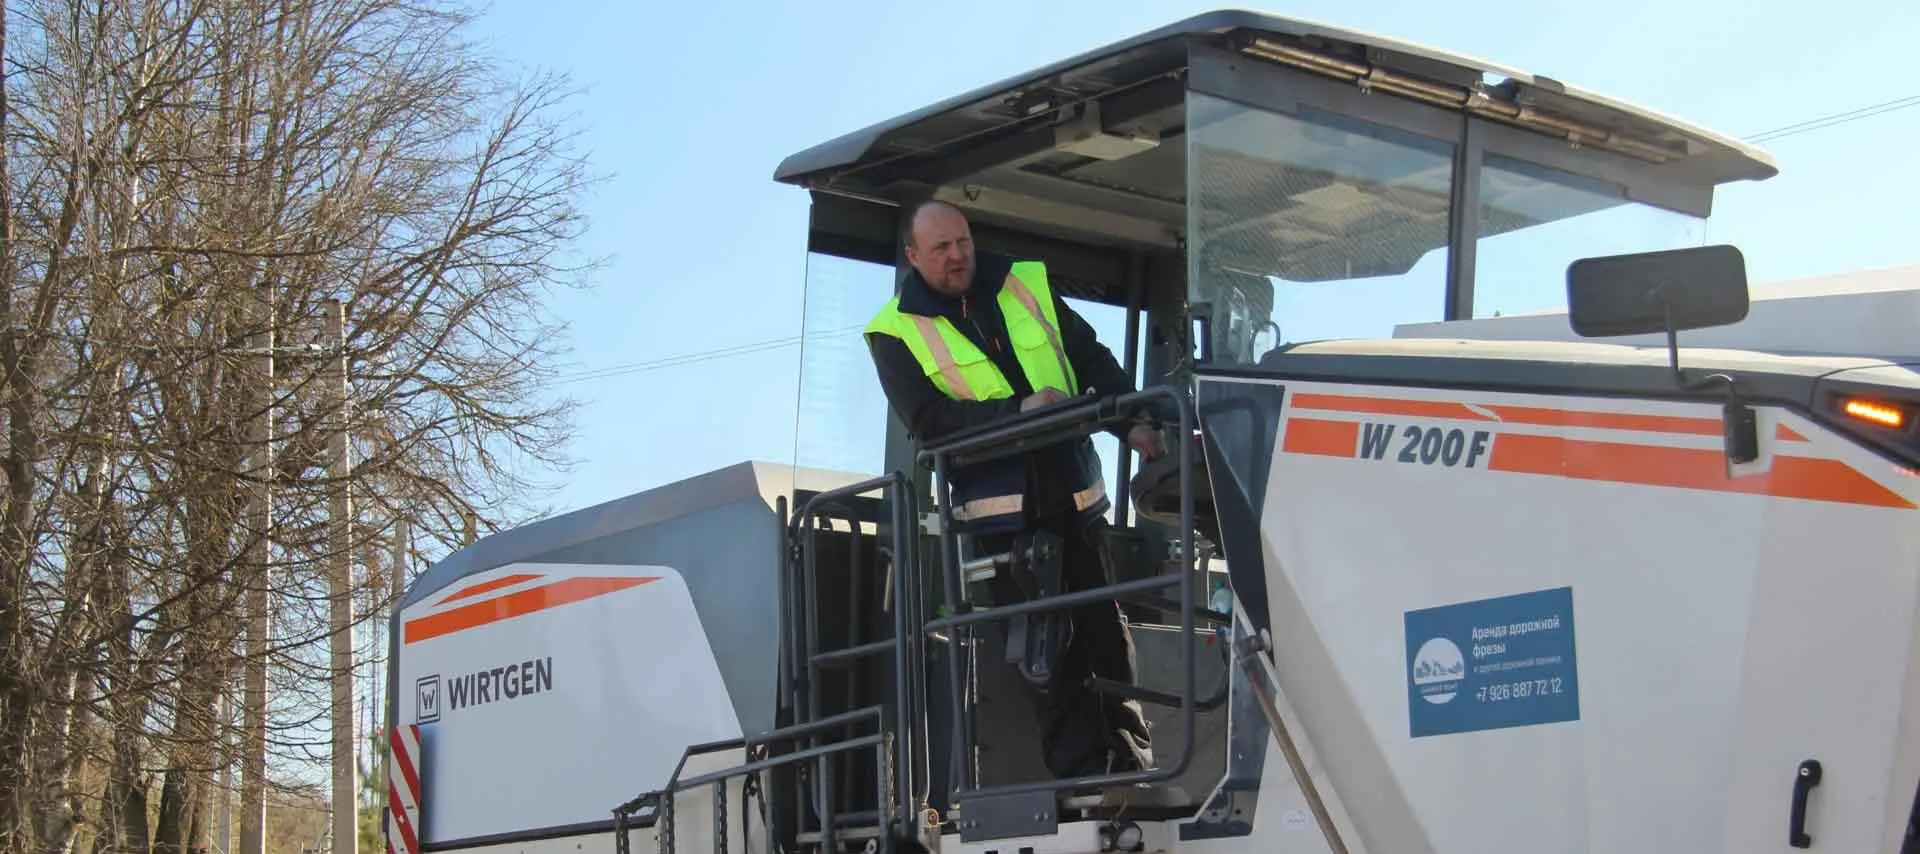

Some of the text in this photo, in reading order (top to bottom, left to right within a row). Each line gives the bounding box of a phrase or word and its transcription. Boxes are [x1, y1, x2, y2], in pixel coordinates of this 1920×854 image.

[1360, 423, 1395, 461] W
[1472, 614, 1560, 641] Аренда дорожной
[1472, 642, 1506, 660] фрезы
[448, 656, 552, 711] WIRTGEN
[1489, 683, 1510, 701] 926
[1512, 681, 1533, 698] 887
[1535, 679, 1549, 697] 72
[1550, 677, 1563, 693] 12
